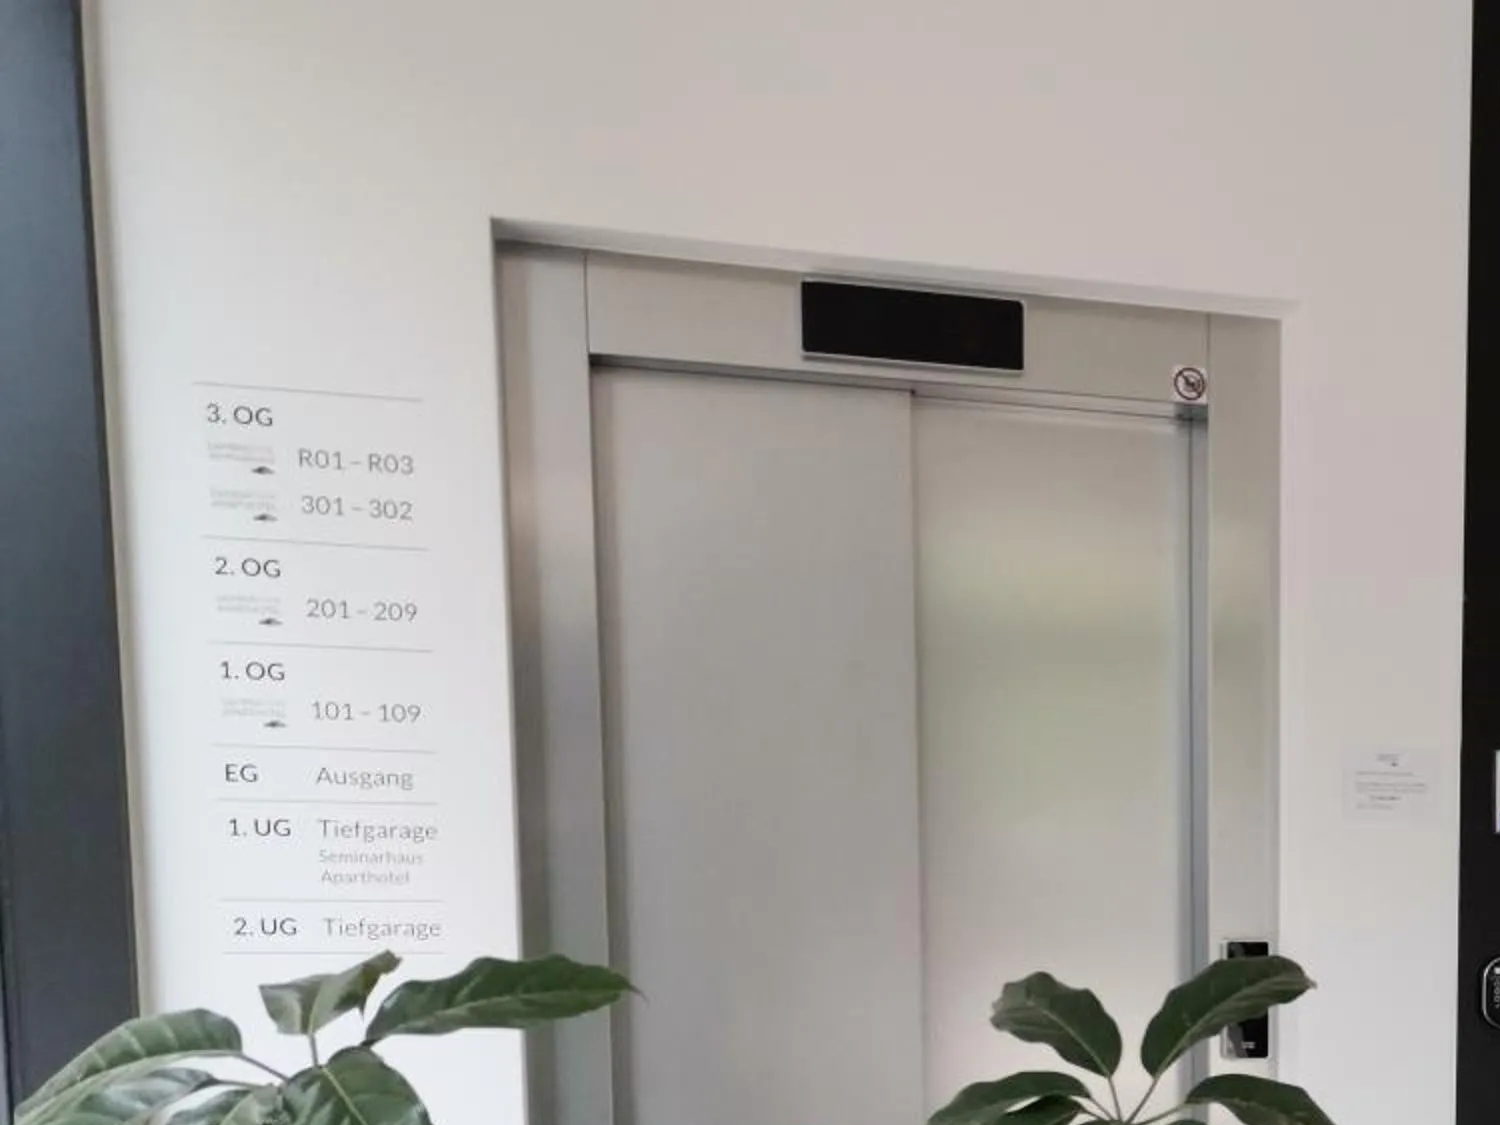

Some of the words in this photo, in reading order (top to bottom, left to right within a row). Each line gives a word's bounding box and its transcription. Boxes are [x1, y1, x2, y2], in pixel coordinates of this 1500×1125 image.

[207, 404, 226, 424] 3.
[233, 406, 274, 427] OG
[298, 449, 345, 471] R01
[368, 453, 414, 475] R03
[301, 496, 345, 517] 301
[369, 500, 413, 521] 302
[215, 557, 234, 576] 2.
[241, 558, 281, 579] OG
[306, 599, 350, 620] 201
[374, 602, 418, 623] 209
[221, 661, 239, 680] 1.
[245, 661, 285, 682] OG
[311, 701, 353, 721] 101
[379, 704, 421, 724] 109
[224, 764, 259, 783] EG
[316, 767, 415, 791] Ausgang
[228, 818, 248, 837] 1.
[254, 819, 292, 837] UG
[319, 818, 439, 843] Tiefgarage
[318, 850, 424, 866] Seminarhaus
[320, 870, 411, 886] Aparthotel
[233, 917, 254, 937] 2.
[260, 918, 298, 937] UG
[323, 917, 442, 941] Tiefgarage
